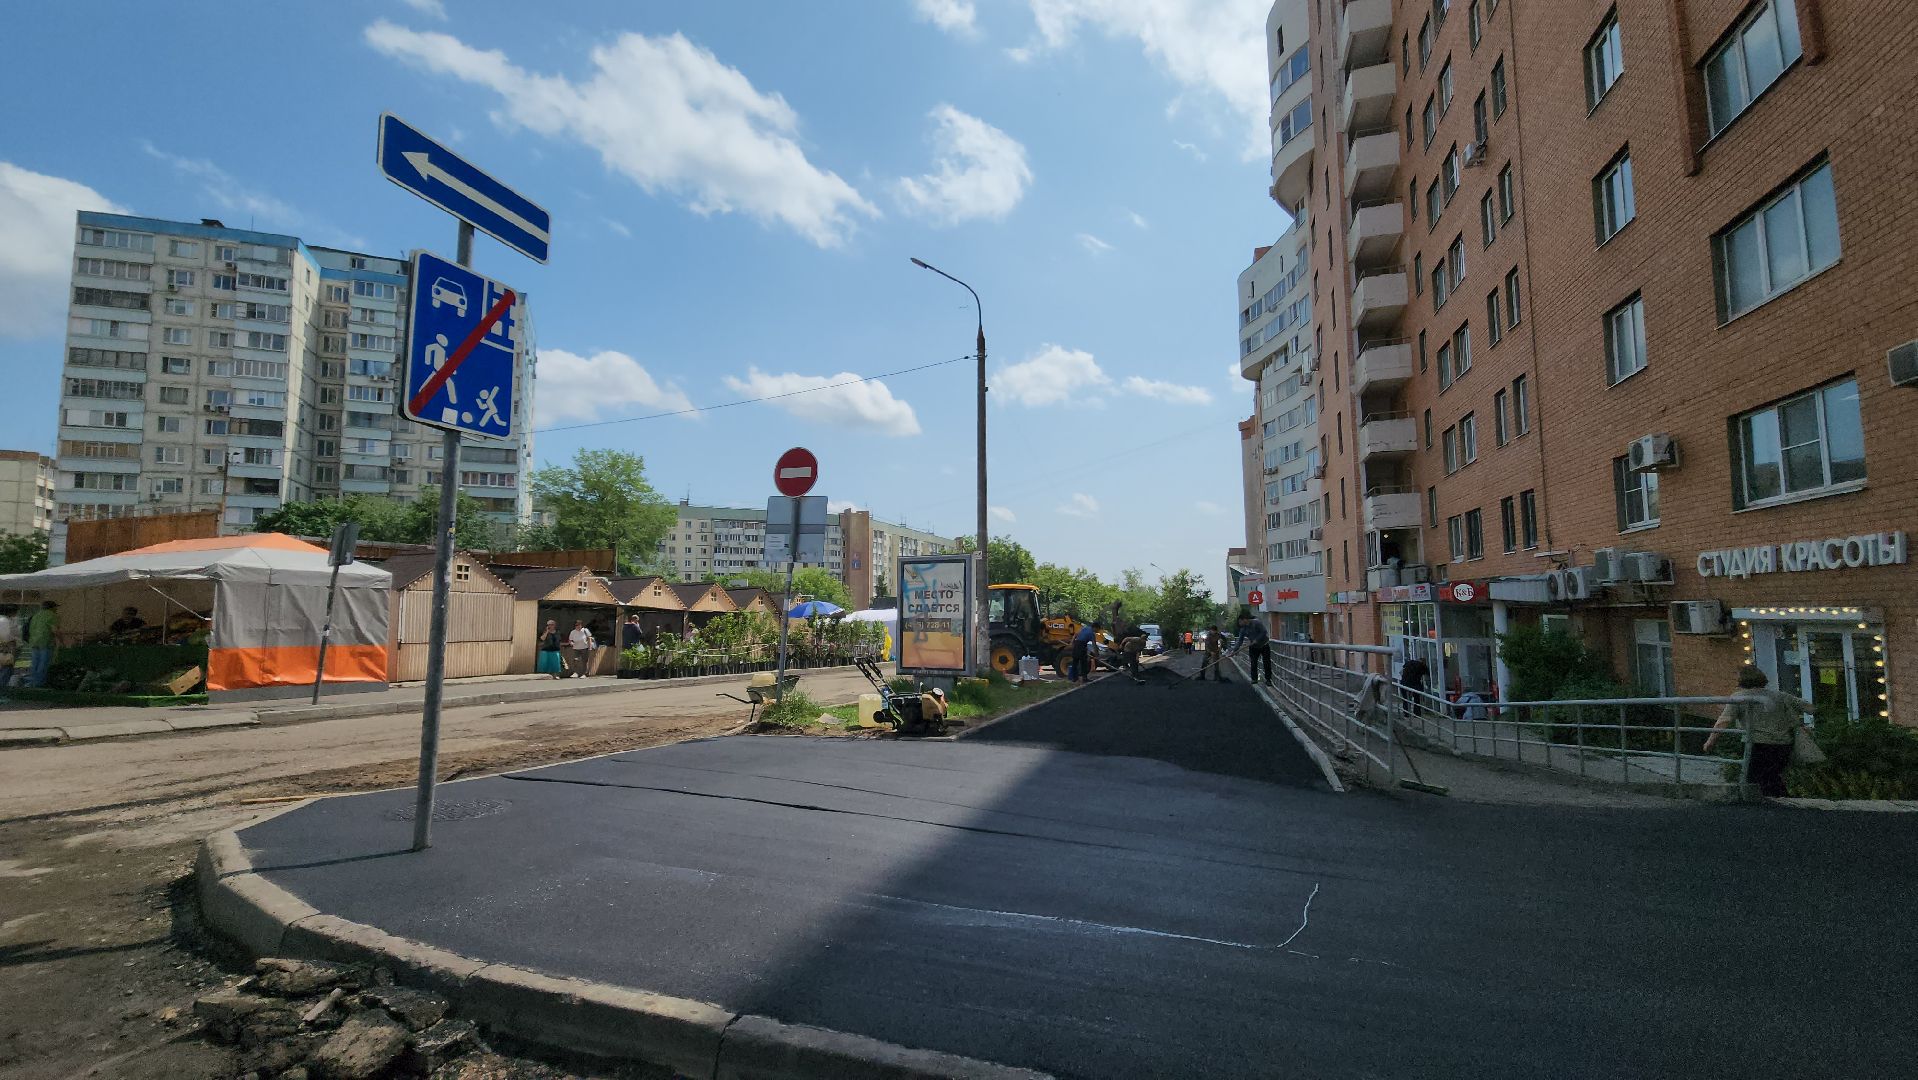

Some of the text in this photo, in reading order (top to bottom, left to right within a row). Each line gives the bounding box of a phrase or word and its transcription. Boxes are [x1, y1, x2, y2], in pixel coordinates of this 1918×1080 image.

[1697, 530, 1905, 580] СТУДИЯ КРАСОТЫ
[914, 589, 954, 600] МЕСТО
[1455, 587, 1474, 598] К&Б
